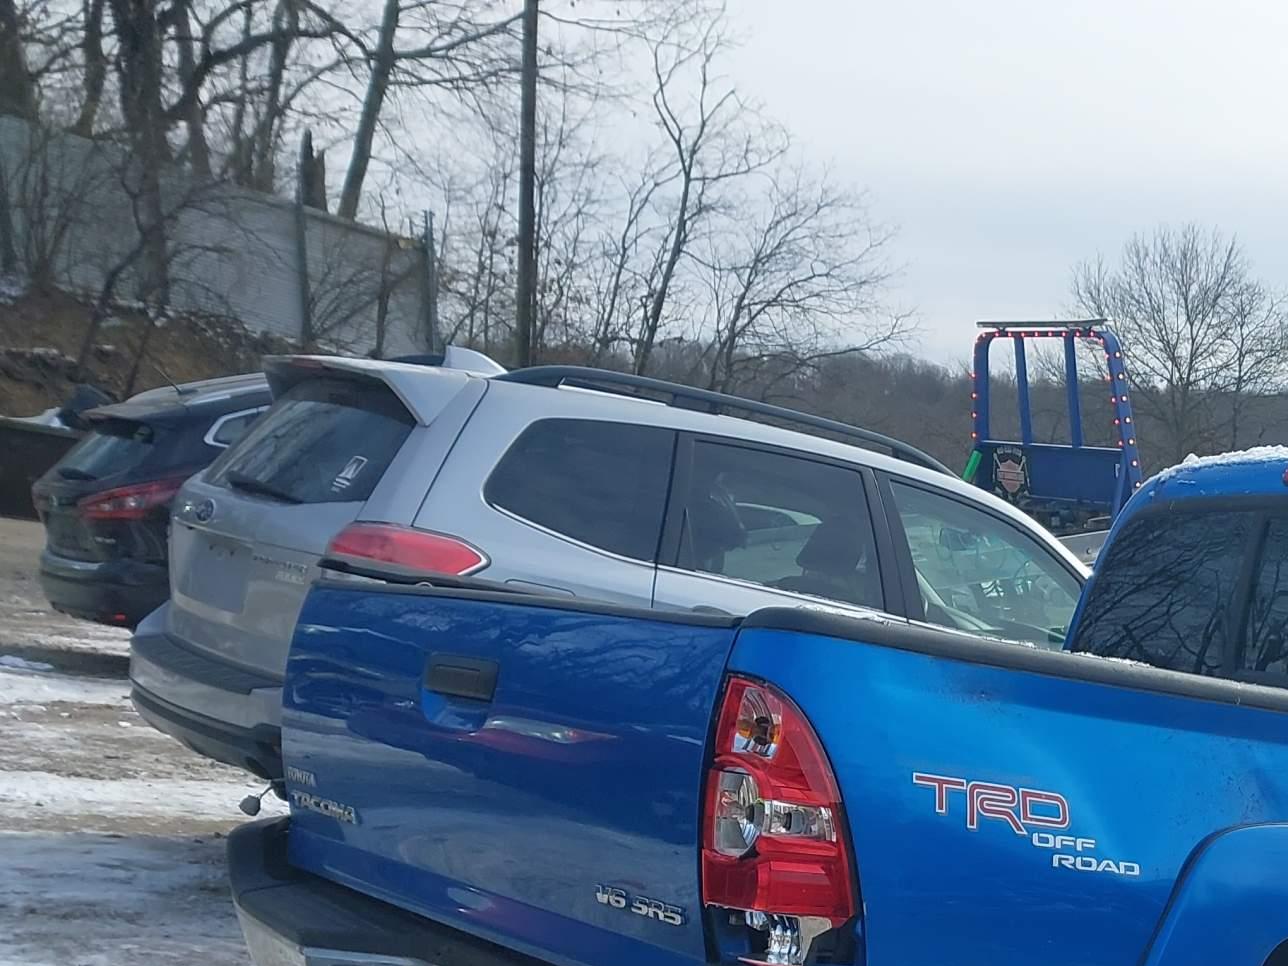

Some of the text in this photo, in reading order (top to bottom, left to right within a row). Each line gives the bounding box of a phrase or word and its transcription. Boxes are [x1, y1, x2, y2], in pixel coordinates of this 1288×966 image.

[290, 789, 357, 825] TACOMA
[912, 772, 1068, 835] TRD
[1032, 832, 1096, 852] OFF
[1052, 854, 1140, 876] ROAD
[594, 884, 682, 926] V6 SR5
